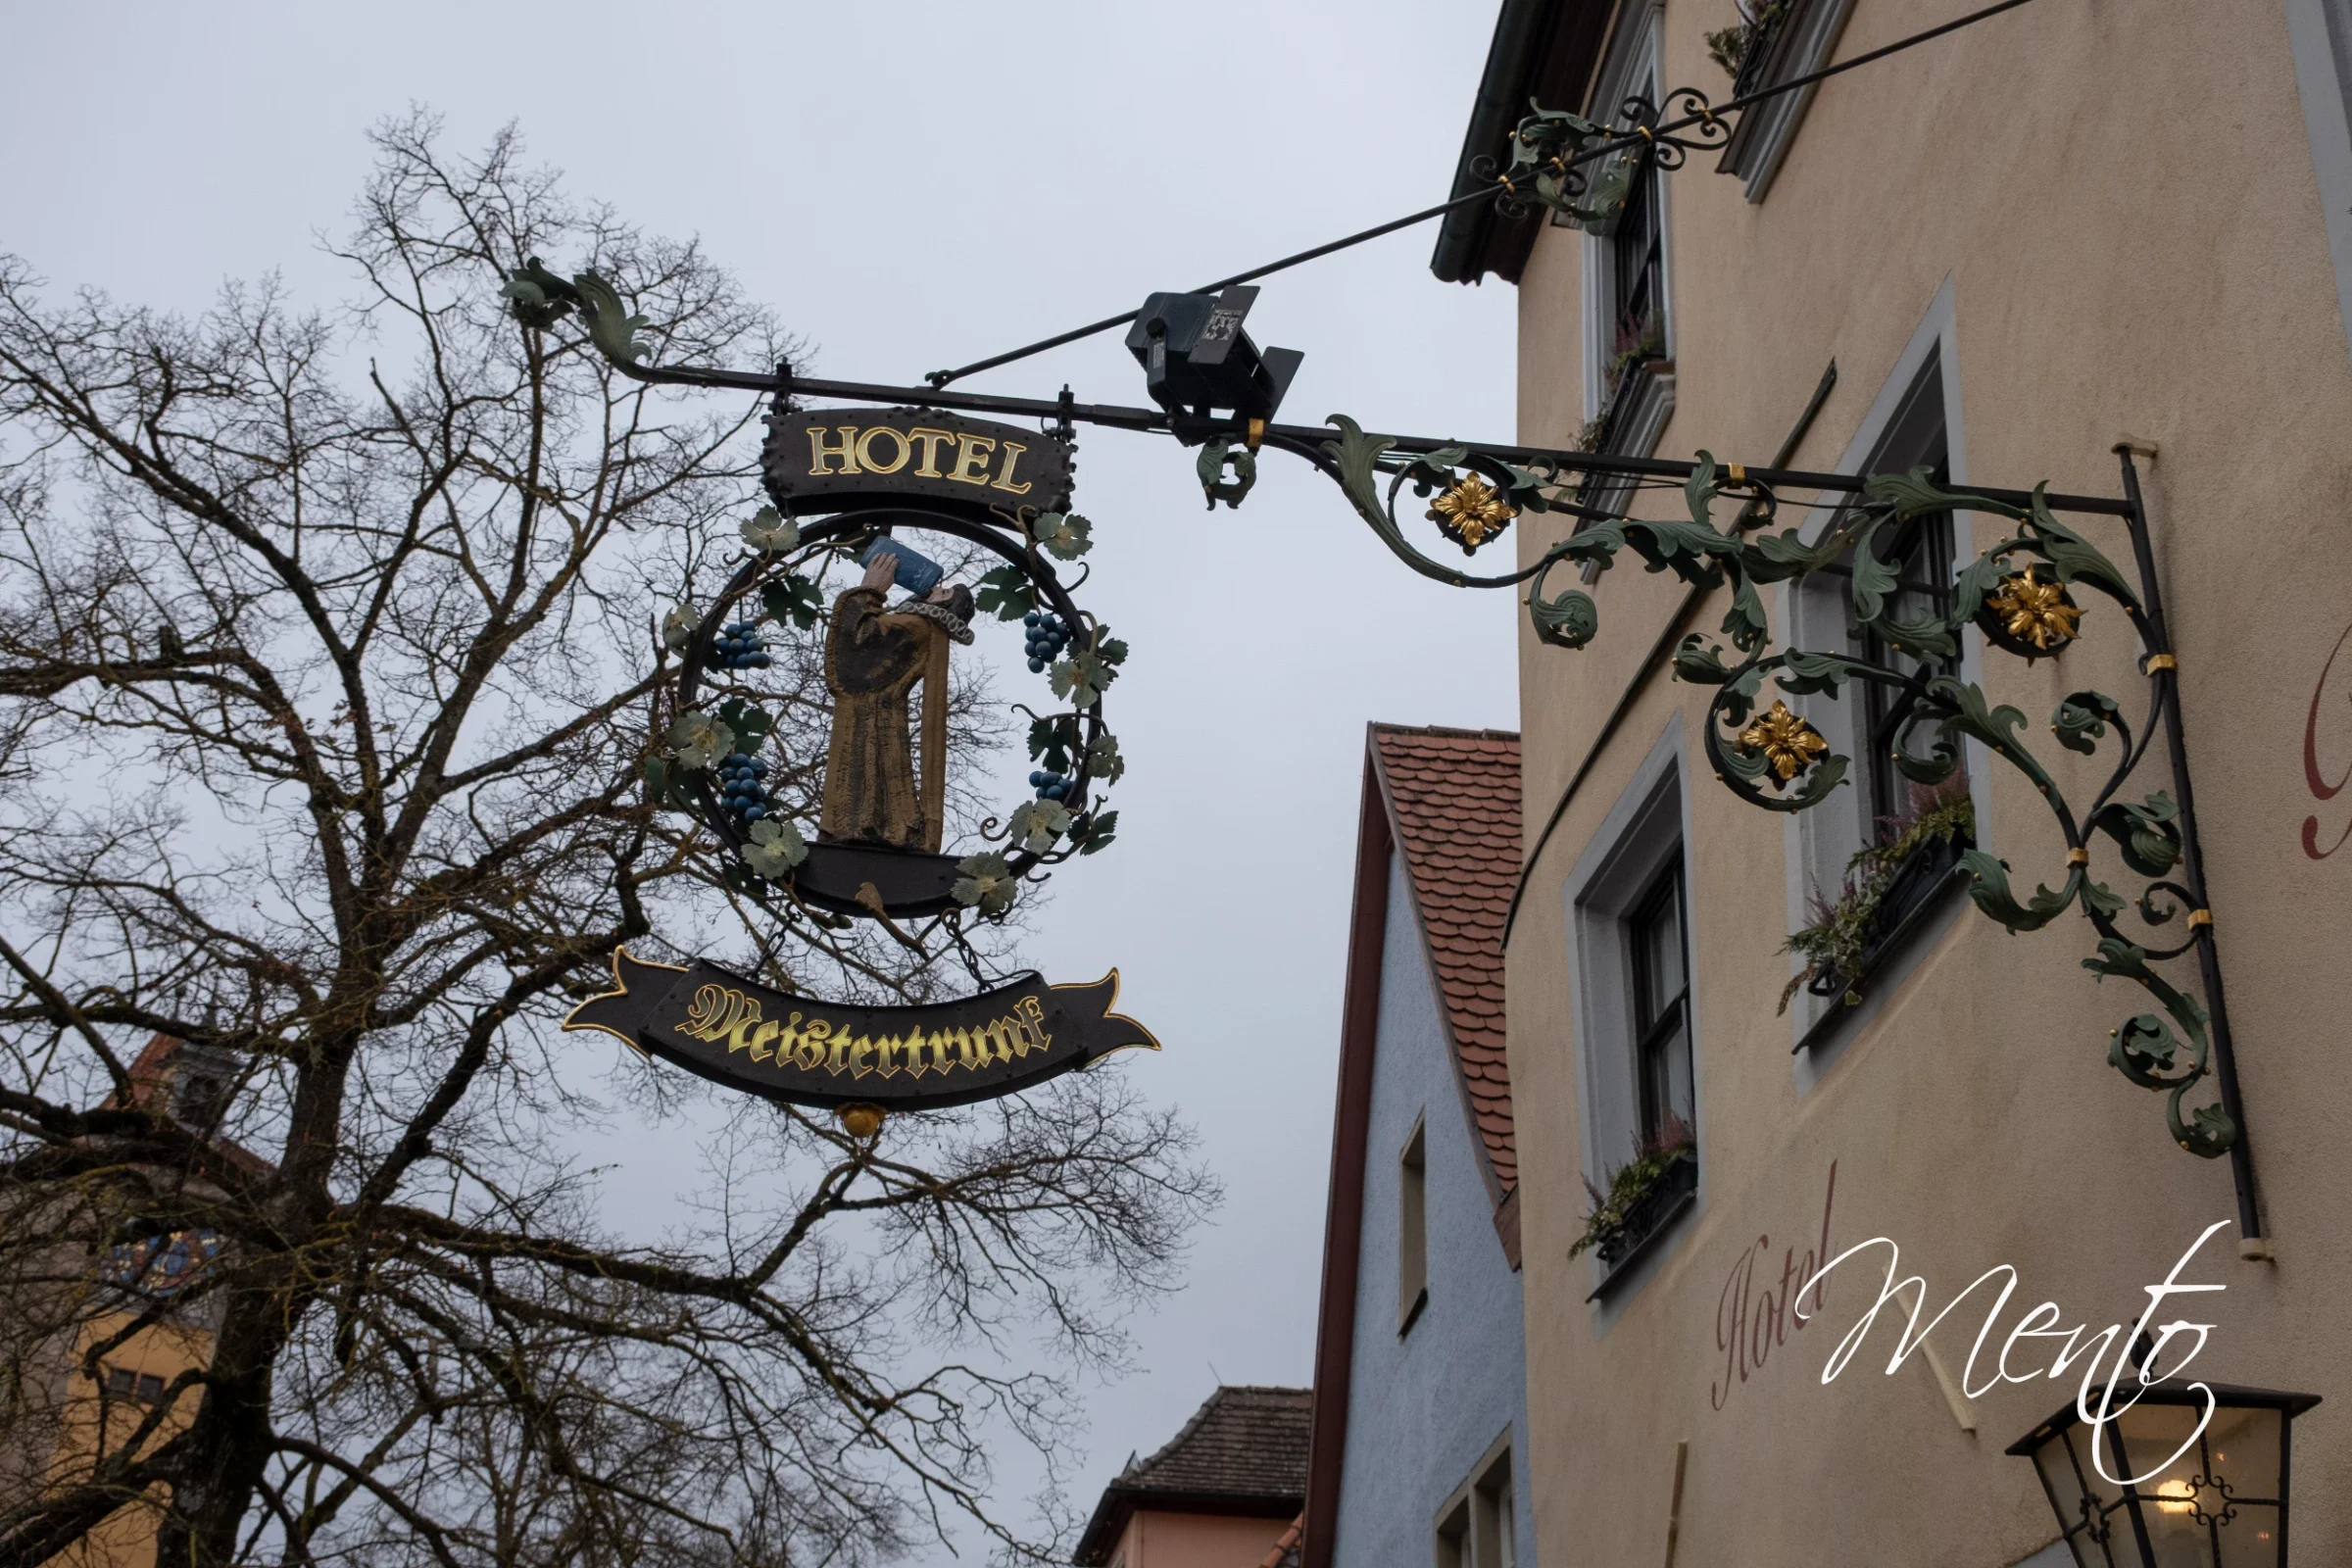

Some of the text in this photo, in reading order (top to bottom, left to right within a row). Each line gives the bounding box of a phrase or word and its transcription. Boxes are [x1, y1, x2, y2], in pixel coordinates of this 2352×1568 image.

[807, 426, 1032, 495] HOTEL
[674, 983, 1053, 1079] Meistertrunk
[1711, 1157, 1838, 1411] Hotel
